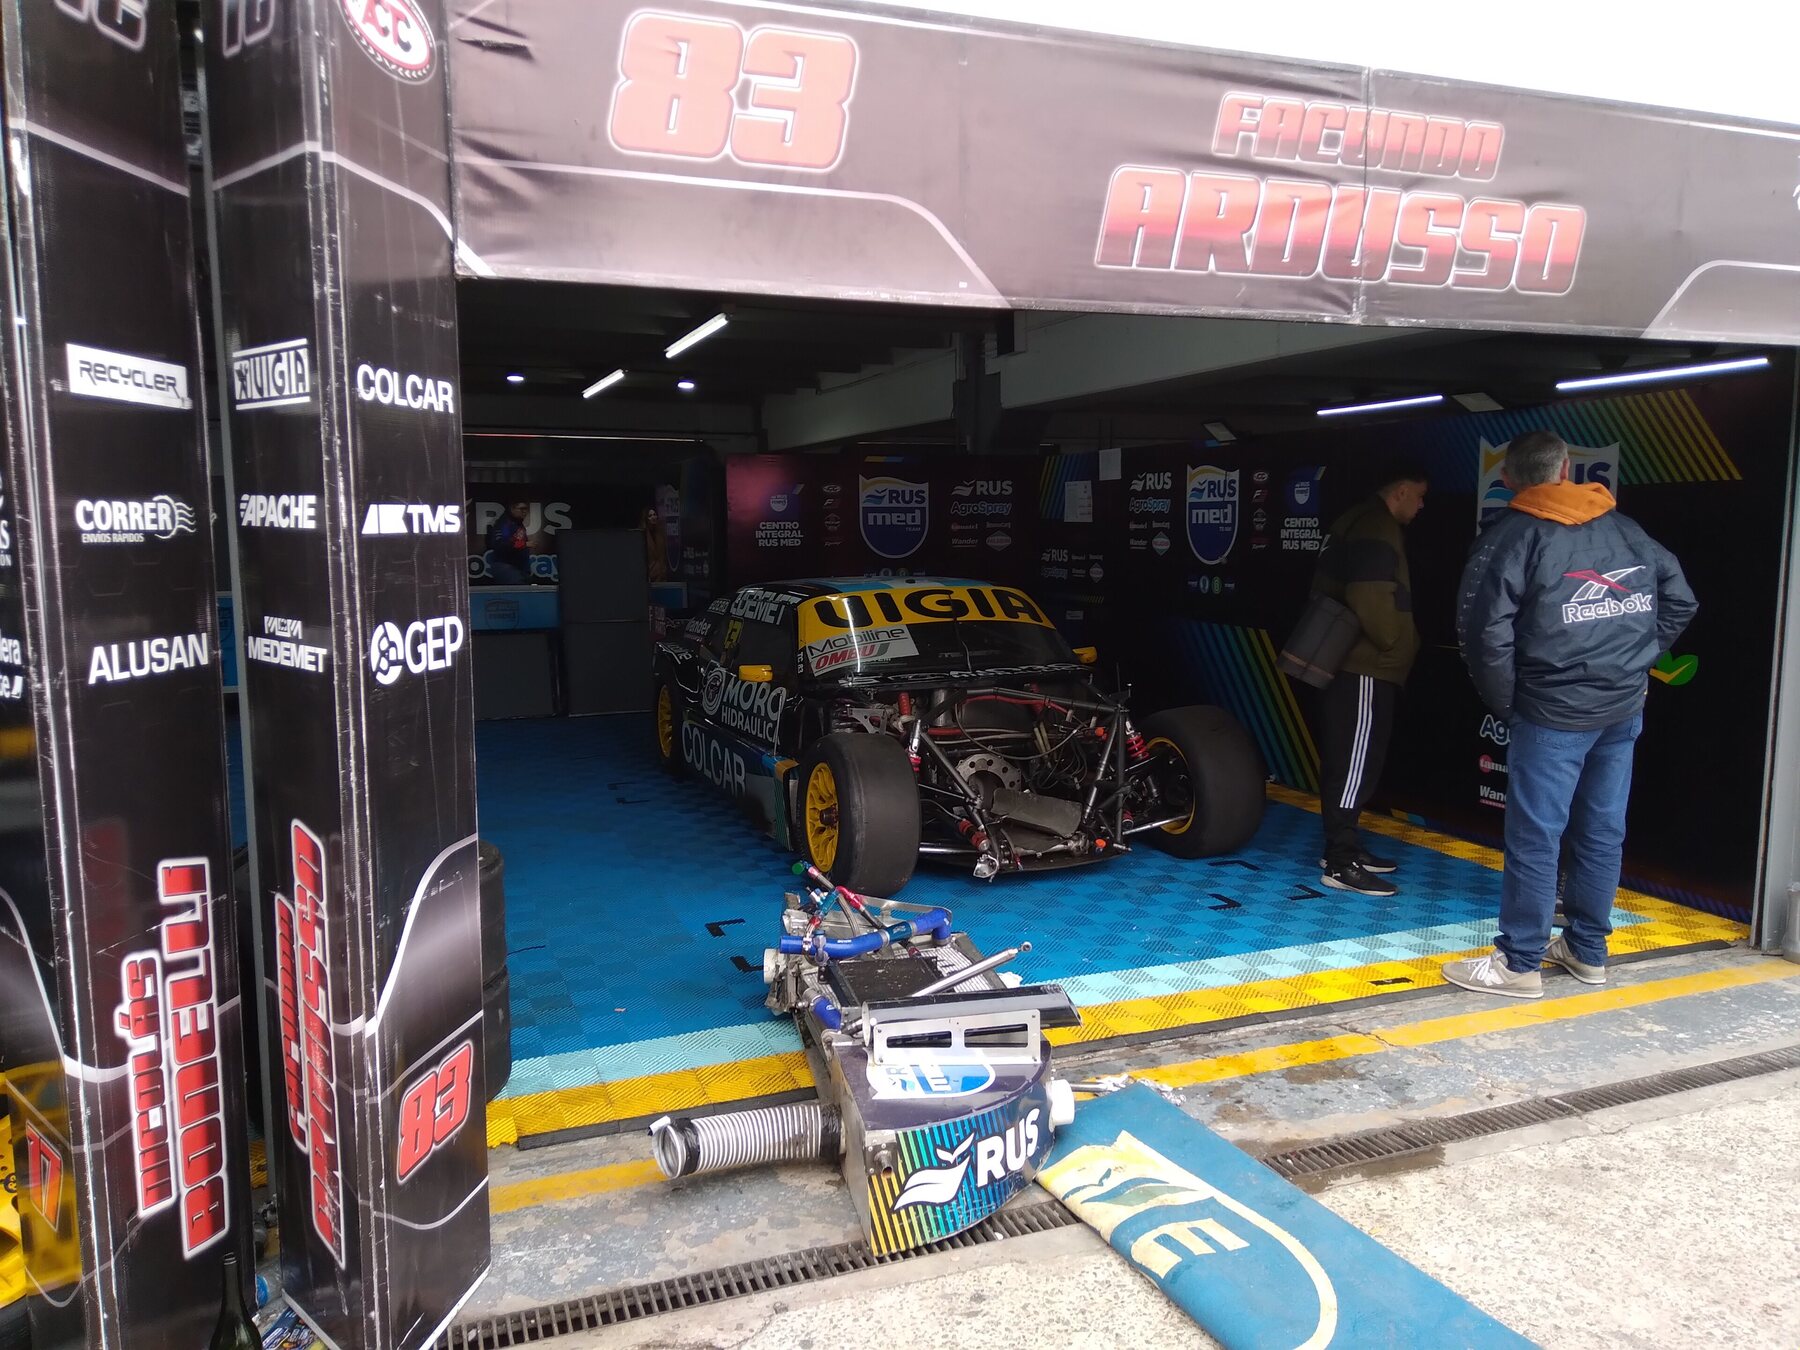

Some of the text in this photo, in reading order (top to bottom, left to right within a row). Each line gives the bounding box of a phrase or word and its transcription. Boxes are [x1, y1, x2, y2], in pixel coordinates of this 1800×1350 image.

[606, 8, 860, 176] 83
[1210, 89, 1506, 184] FACUNDO
[1092, 163, 1588, 298] ARDUSSO
[79, 360, 179, 393] RECYCLER
[356, 364, 454, 414] COLCAR
[975, 480, 1013, 497] RUS
[1145, 471, 1172, 491] RUS
[1207, 479, 1237, 499] RUS
[241, 495, 317, 529] APACHE
[888, 489, 926, 505] RUS
[950, 500, 1012, 517] AgroSpray
[1128, 497, 1171, 513] AgroSpray
[407, 505, 461, 534] TMS
[759, 521, 800, 530] CENTRO
[867, 509, 921, 527] med
[1191, 503, 1233, 525] med
[1284, 517, 1320, 529] CENTRO
[112, 532, 144, 543] RÁPIDOS
[755, 530, 804, 539] INTEGRAL
[758, 538, 802, 547] RUS MED
[1280, 528, 1323, 540] INTEGRAL
[1282, 539, 1321, 551] RUS MED
[1562, 593, 1652, 624] Reebok
[248, 636, 328, 673] MEDEMET
[405, 616, 464, 674] GEP
[807, 629, 904, 656] Mobiline
[88, 634, 209, 685] ALUSAN
[723, 676, 786, 722] MORO
[682, 721, 746, 800] COLCAR
[157, 856, 230, 1259] BONELLI
[290, 817, 348, 1270] ARDUSSO
[115, 951, 175, 1217] NICOLÁS
[397, 1038, 474, 1185] 83
[975, 1109, 1041, 1188] RUS
